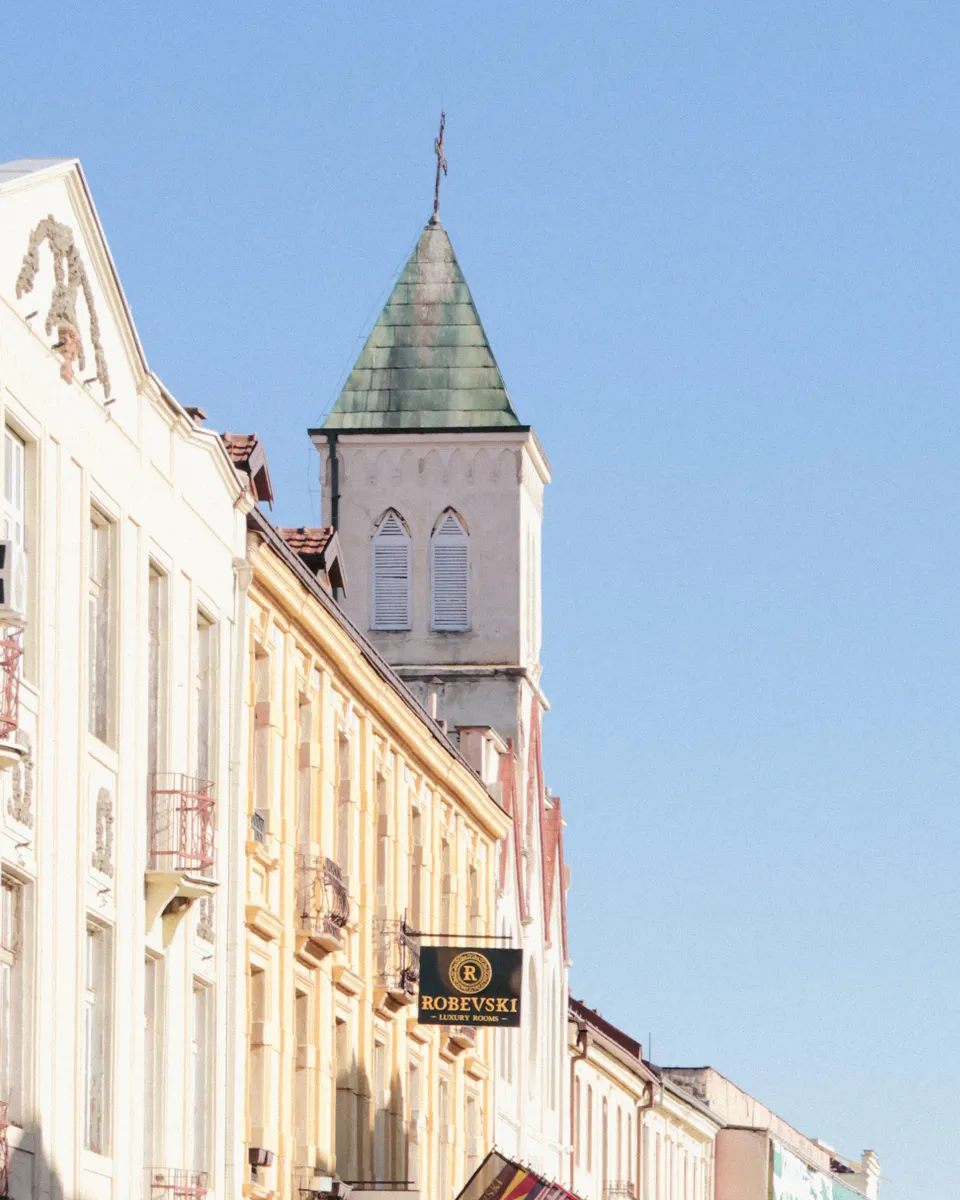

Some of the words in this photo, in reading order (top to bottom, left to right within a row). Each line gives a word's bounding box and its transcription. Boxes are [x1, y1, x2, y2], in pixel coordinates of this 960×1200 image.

[463, 965, 477, 981] R
[421, 995, 518, 1013] ROBEVSKI
[439, 1013, 470, 1021] LUXURY
[473, 1014, 499, 1022] ROOMS
